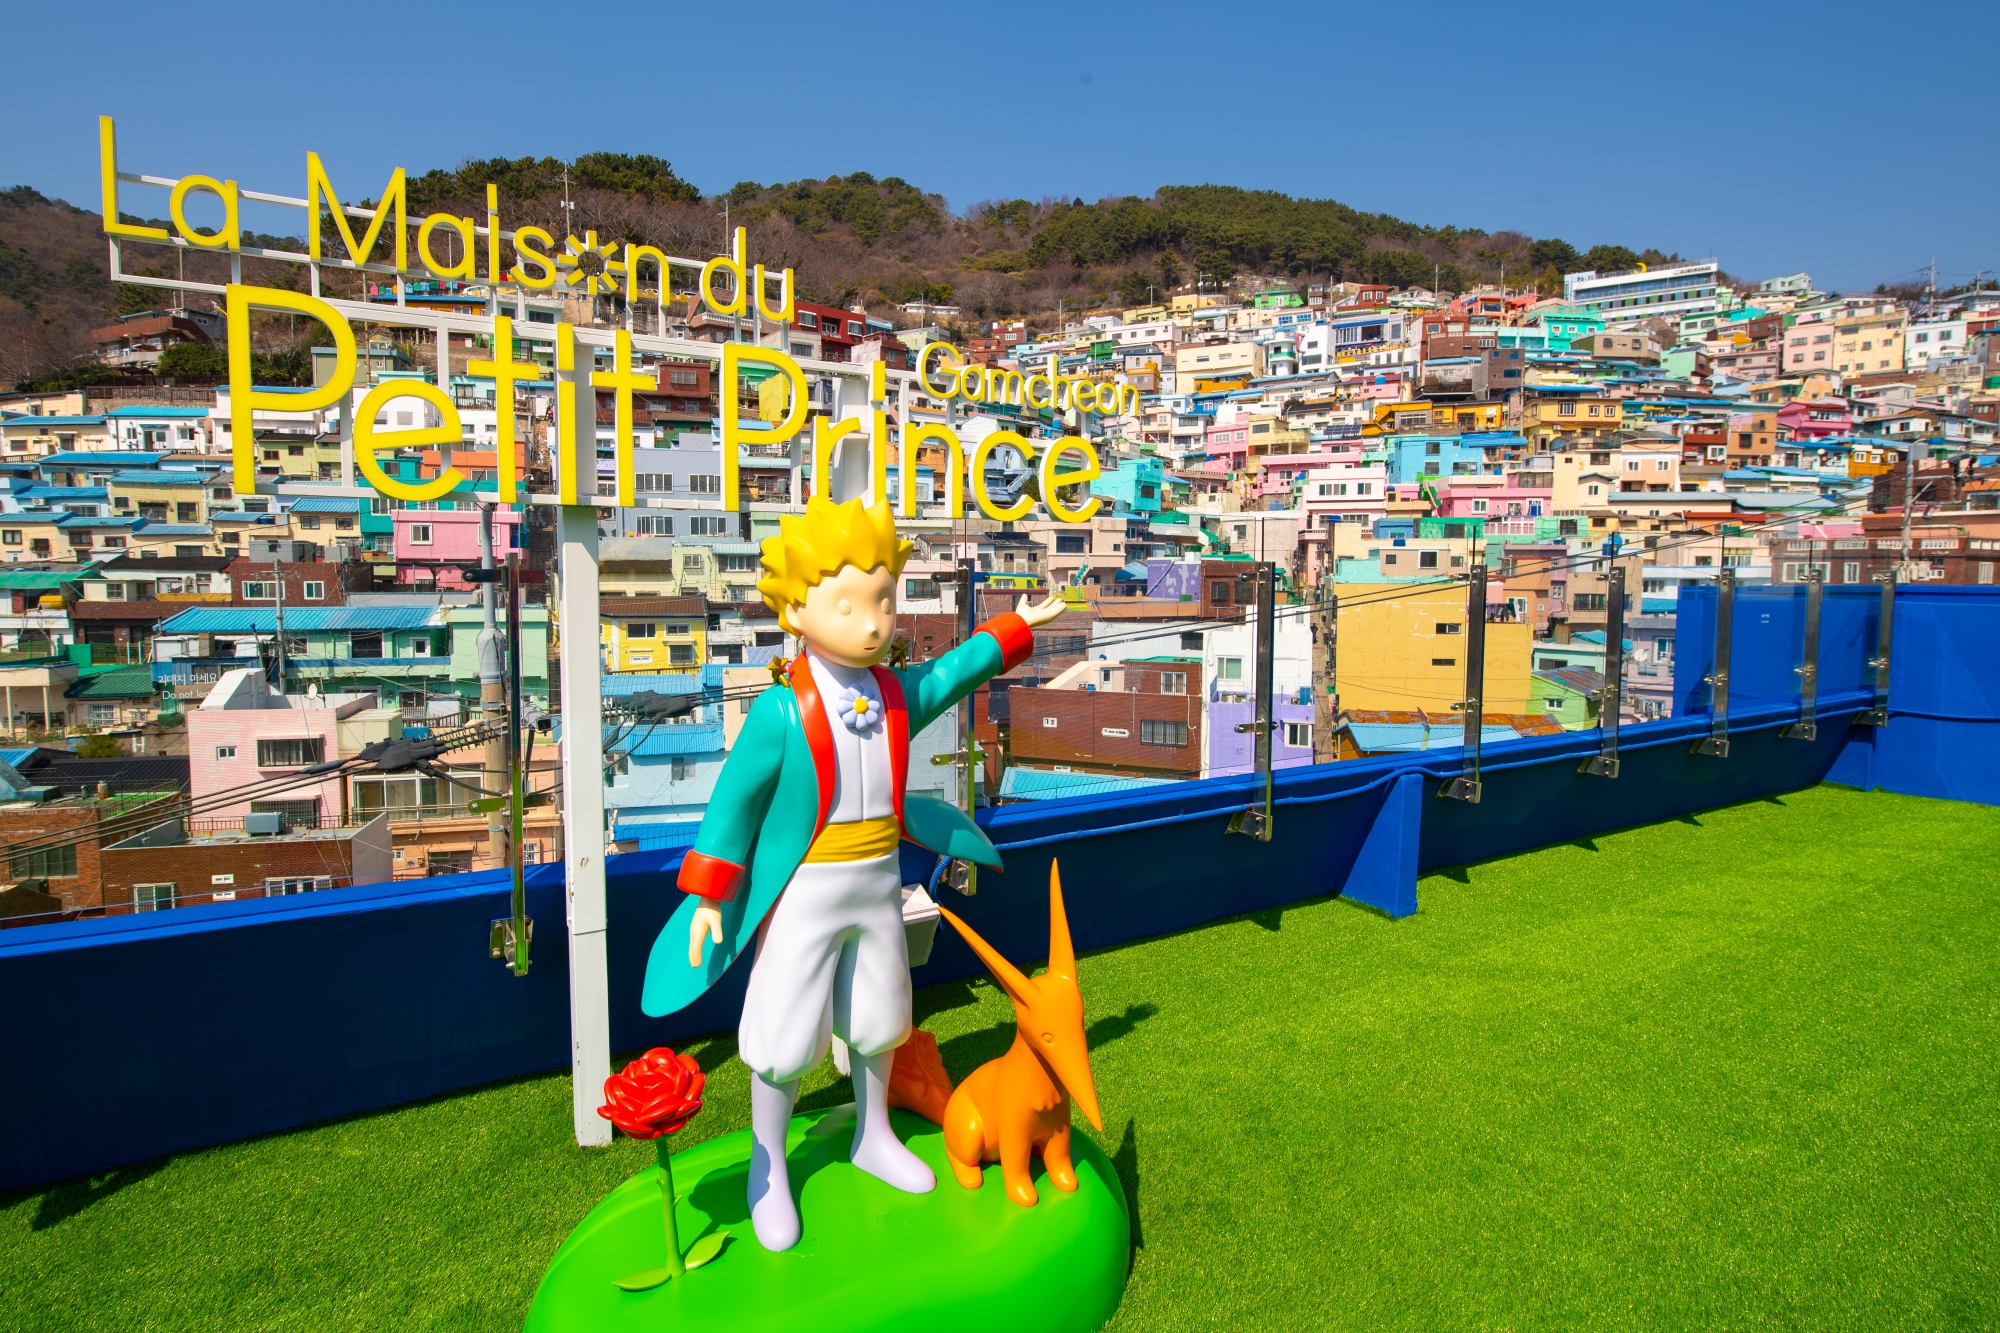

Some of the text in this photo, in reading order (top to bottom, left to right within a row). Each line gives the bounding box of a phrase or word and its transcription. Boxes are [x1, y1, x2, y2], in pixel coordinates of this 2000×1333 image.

[99, 115, 240, 252] La
[701, 226, 795, 323] du
[226, 283, 1102, 524] Petit Prince
[917, 340, 1140, 417] Gamcheon
[157, 672, 217, 687] 기대지 마세요
[162, 690, 177, 700] Do
[179, 690, 194, 699] not
